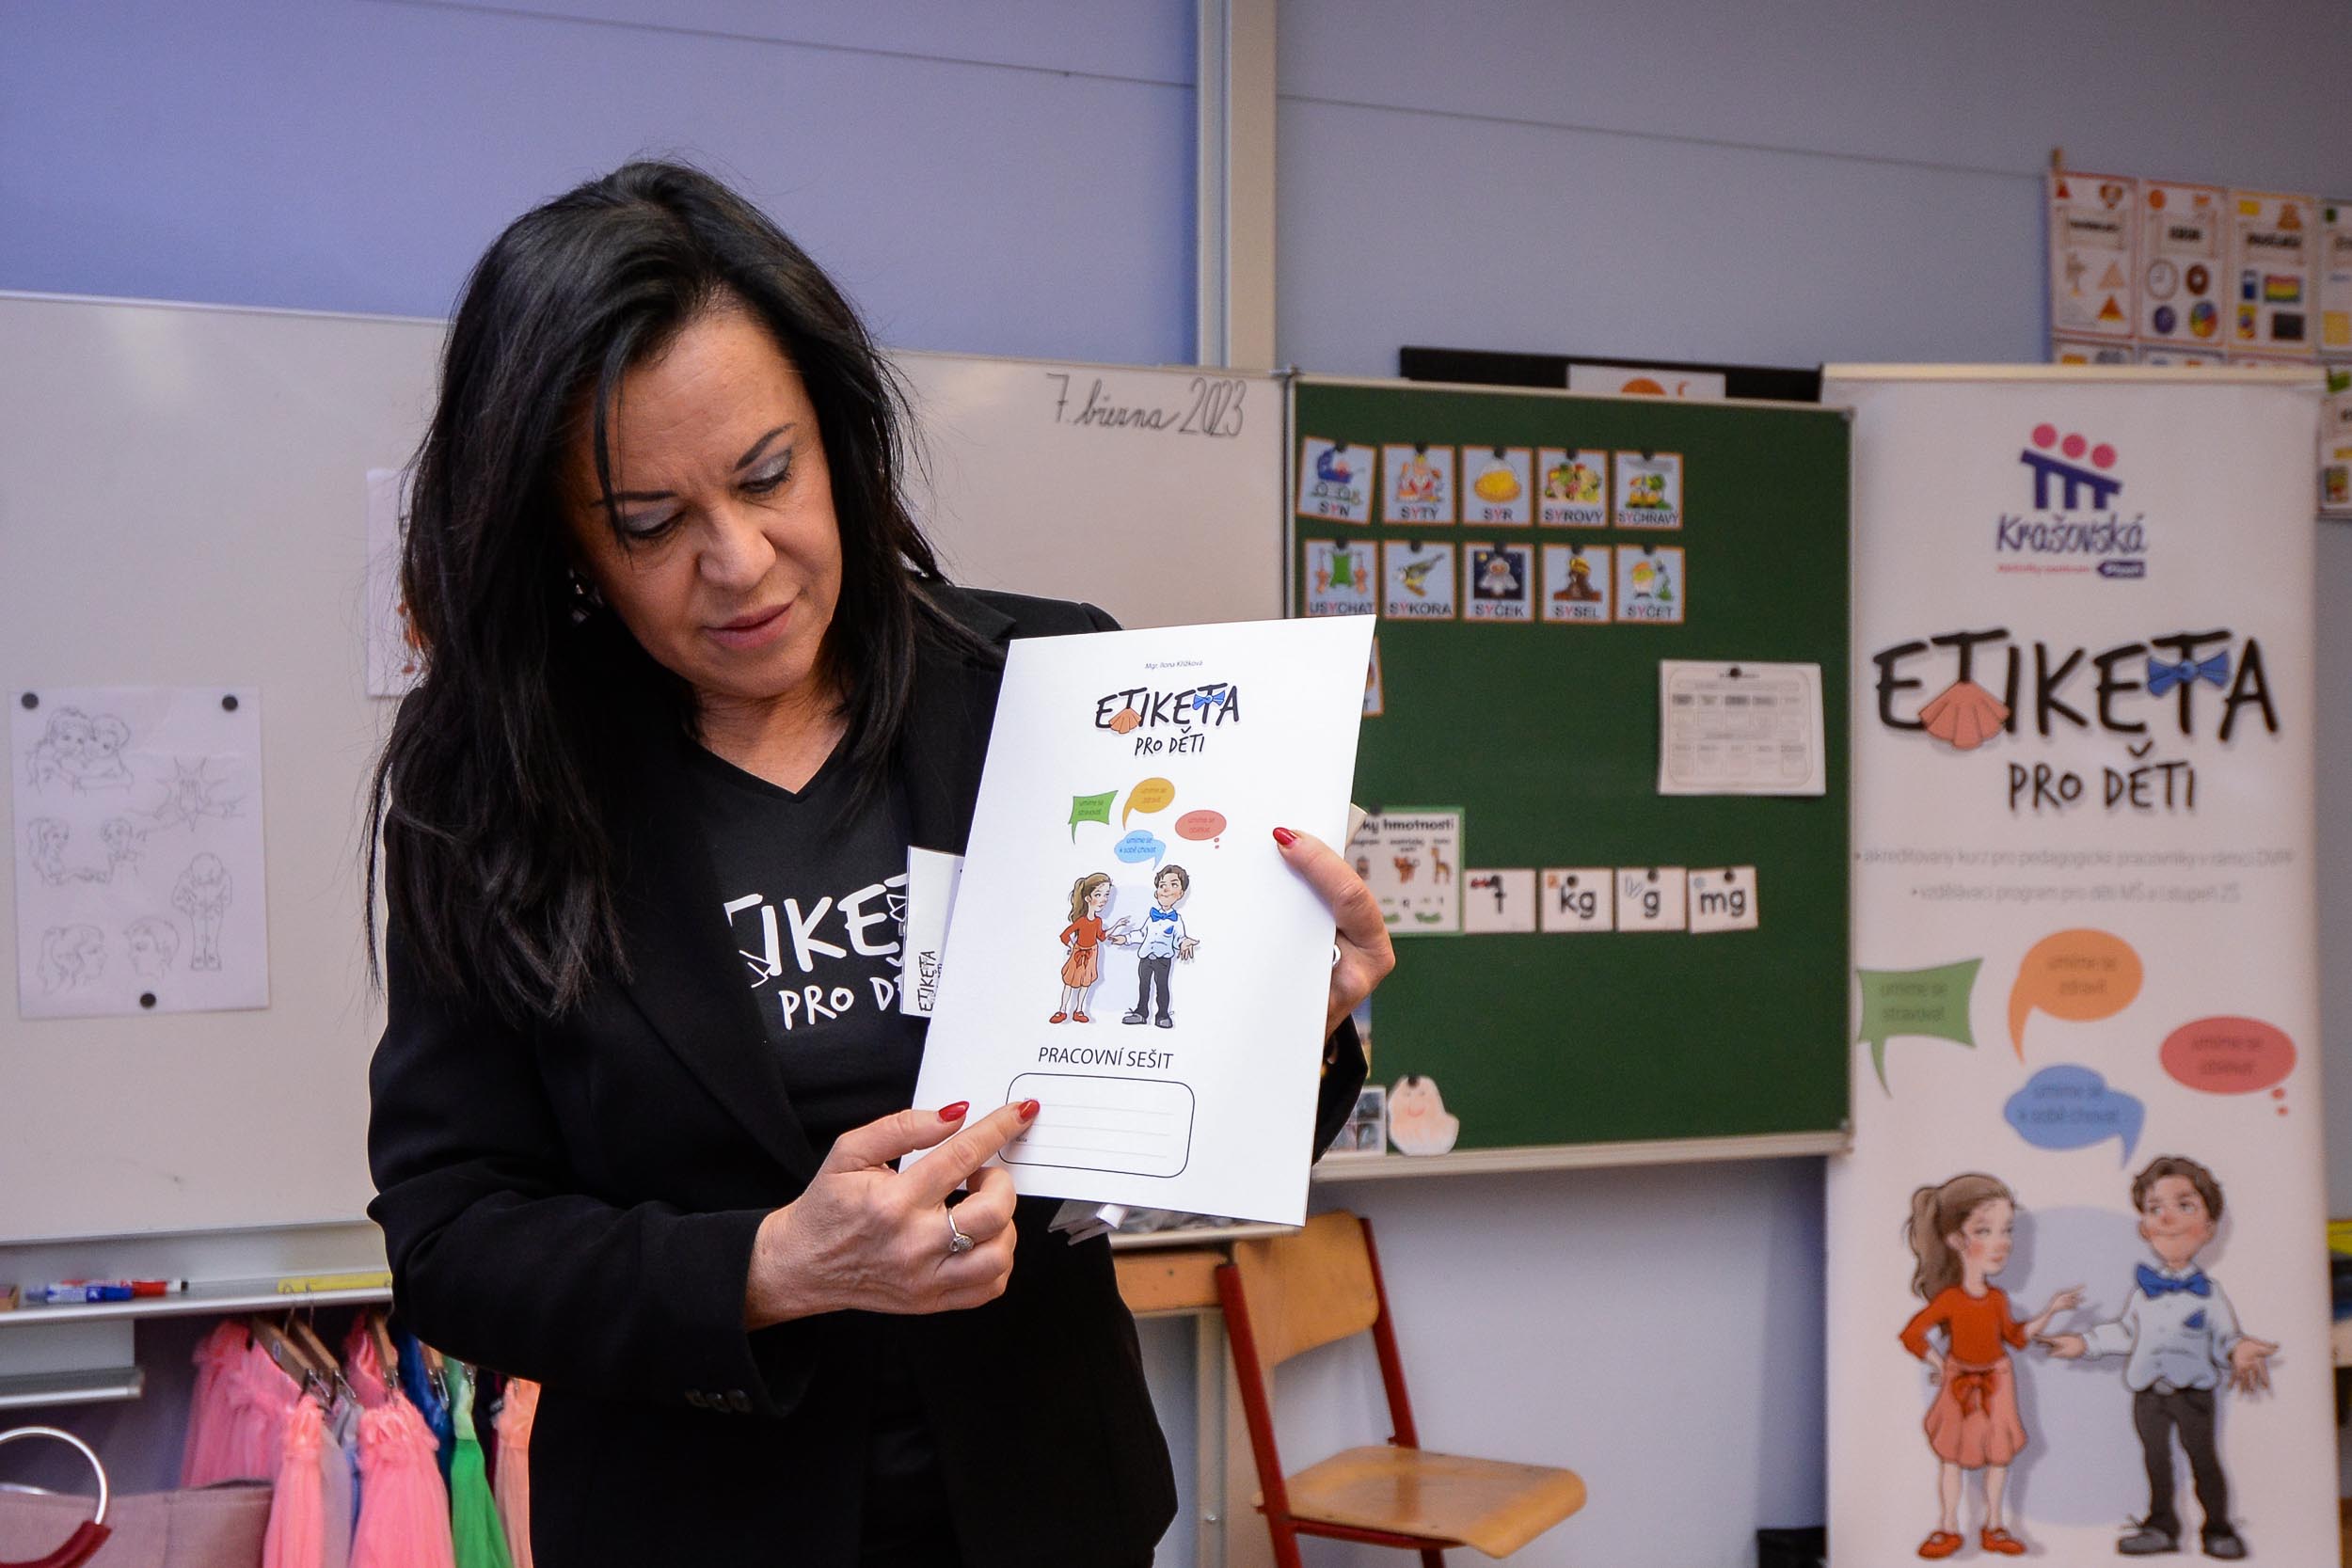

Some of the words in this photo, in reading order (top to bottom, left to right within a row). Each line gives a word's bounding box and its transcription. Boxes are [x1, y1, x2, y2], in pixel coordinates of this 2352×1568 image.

[1178, 376, 1247, 437] 2023
[1319, 501, 1350, 517] SYN
[1309, 601, 1374, 615] USYCHAT
[1555, 604, 1599, 618] SYSEL
[1873, 628, 2280, 745] ETIKETA
[1095, 683, 1239, 733] ETIKETA
[1135, 736, 1163, 755] PRO
[1168, 726, 1205, 753] DĚTI
[2009, 763, 2083, 811] PRO
[2102, 740, 2196, 811] DĚTI
[1383, 817, 1454, 831] hmotnosti
[1560, 882, 1597, 920] kg
[1643, 890, 1661, 920] g
[1699, 888, 1747, 918] mg
[723, 873, 909, 976] IKE
[917, 951, 936, 1012] ETIKETA
[778, 985, 854, 1031] PRO
[1038, 1047, 1124, 1066] PRACOVNÍ
[1126, 1049, 1174, 1069] SEŠIT
